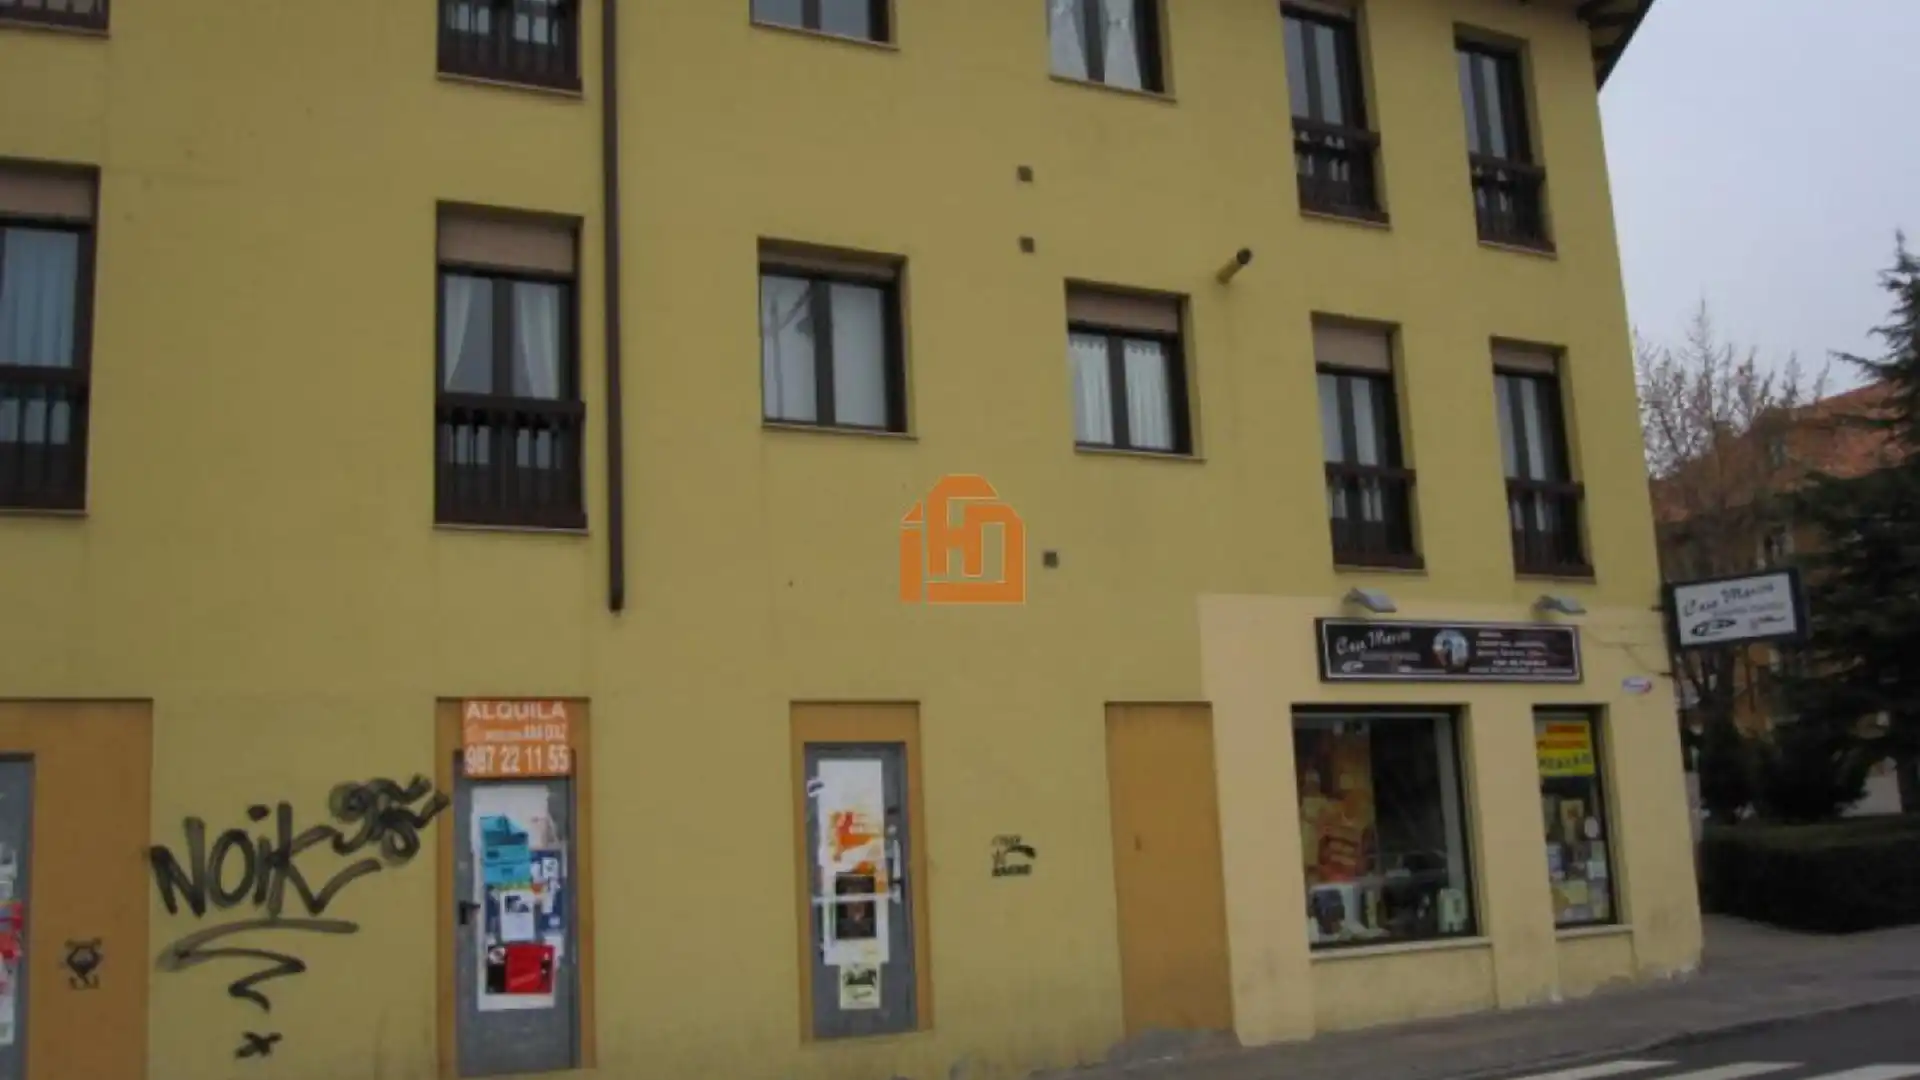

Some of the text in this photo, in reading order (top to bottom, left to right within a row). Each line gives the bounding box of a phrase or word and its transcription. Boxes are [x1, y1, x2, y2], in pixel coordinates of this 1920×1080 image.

[465, 701, 566, 720] ALQUILA
[499, 745, 521, 774] 22
[523, 747, 543, 773] 11
